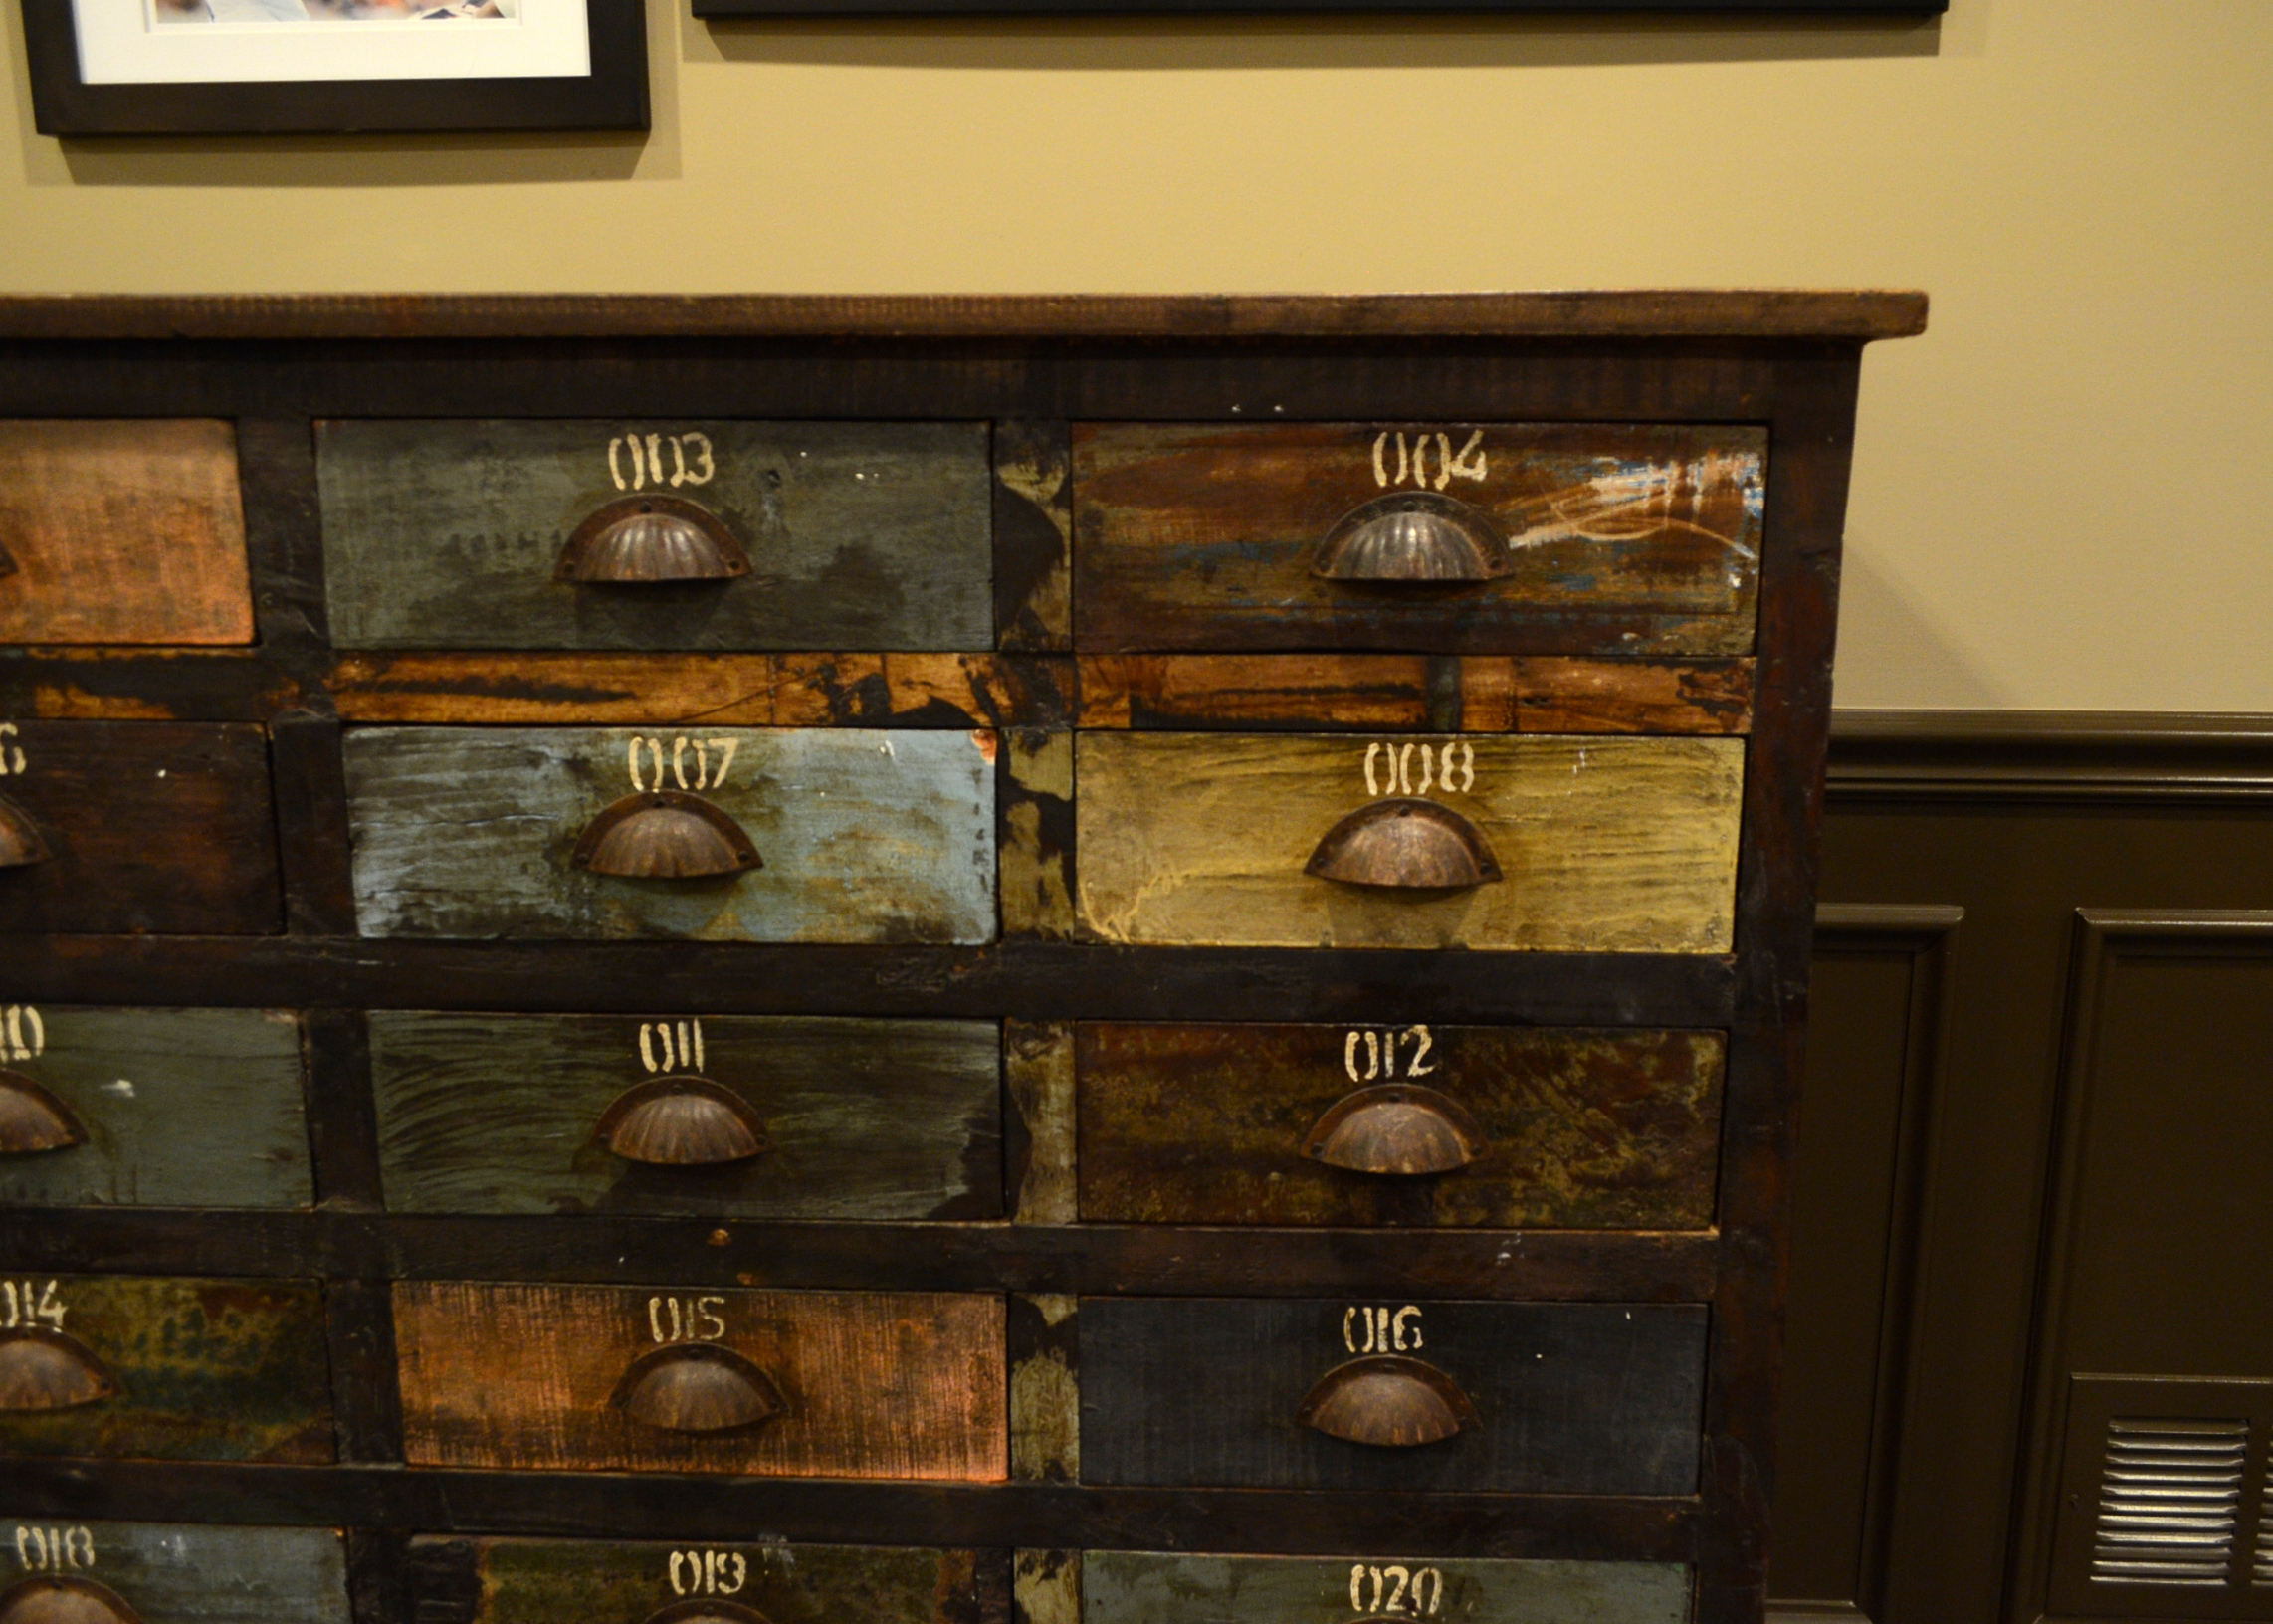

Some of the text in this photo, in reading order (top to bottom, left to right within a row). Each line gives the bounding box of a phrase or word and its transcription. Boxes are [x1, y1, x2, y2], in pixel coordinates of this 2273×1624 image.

[608, 432, 716, 491] 003
[1372, 431, 1488, 491] 004
[629, 736, 739, 793] 007
[1364, 742, 1475, 796] 008
[640, 1017, 705, 1073] 011
[1344, 1024, 1435, 1082] 012
[649, 1296, 725, 1343] 015
[1343, 1305, 1423, 1353] 016
[16, 1525, 96, 1571] 018
[670, 1550, 747, 1595] 019
[1349, 1564, 1442, 1617] 020
